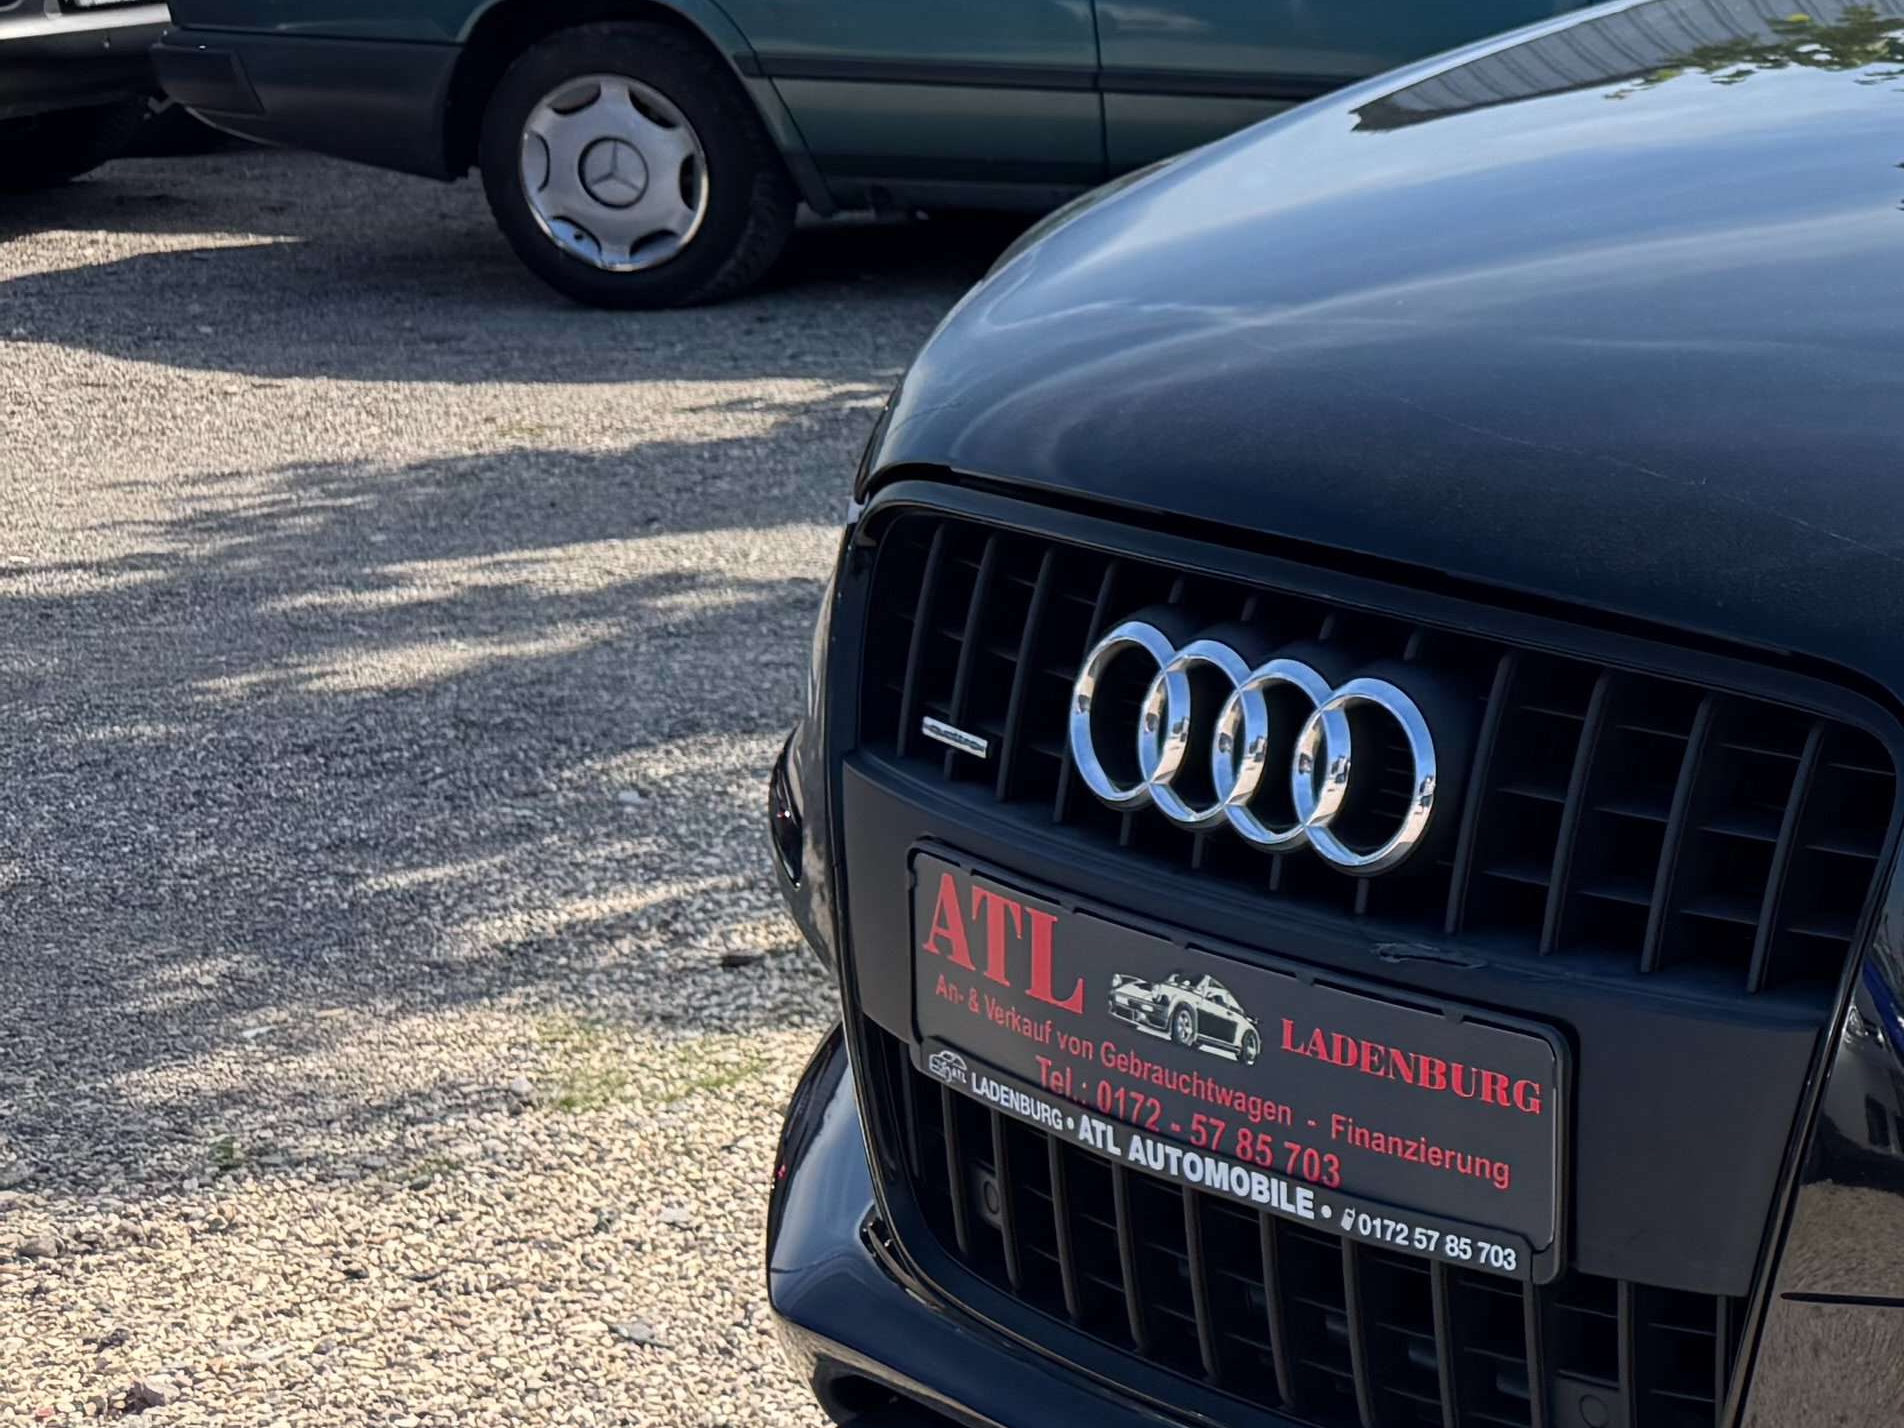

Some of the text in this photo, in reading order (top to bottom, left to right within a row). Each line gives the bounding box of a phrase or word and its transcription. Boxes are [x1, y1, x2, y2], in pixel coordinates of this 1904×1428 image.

[921, 872, 1084, 1015] ATL
[935, 974, 964, 1002] An-
[967, 987, 980, 1014] &
[984, 994, 1053, 1045] Verkauf
[1057, 1027, 1094, 1061] von
[1099, 1042, 1293, 1124] Gebrauchtwagen
[1331, 1113, 1511, 1190] Finanzierung
[1035, 1055, 1088, 1105] Tel.:
[1096, 1080, 1162, 1133] 0172
[1189, 1114, 1226, 1152] 57
[1236, 1127, 1273, 1168] 85
[1283, 1141, 1341, 1189] 703
[1280, 1018, 1542, 1115] LADENBURG
[970, 1072, 1517, 1272] LADENBURG ATL AUTOMOBILE 0172 57 85 703
